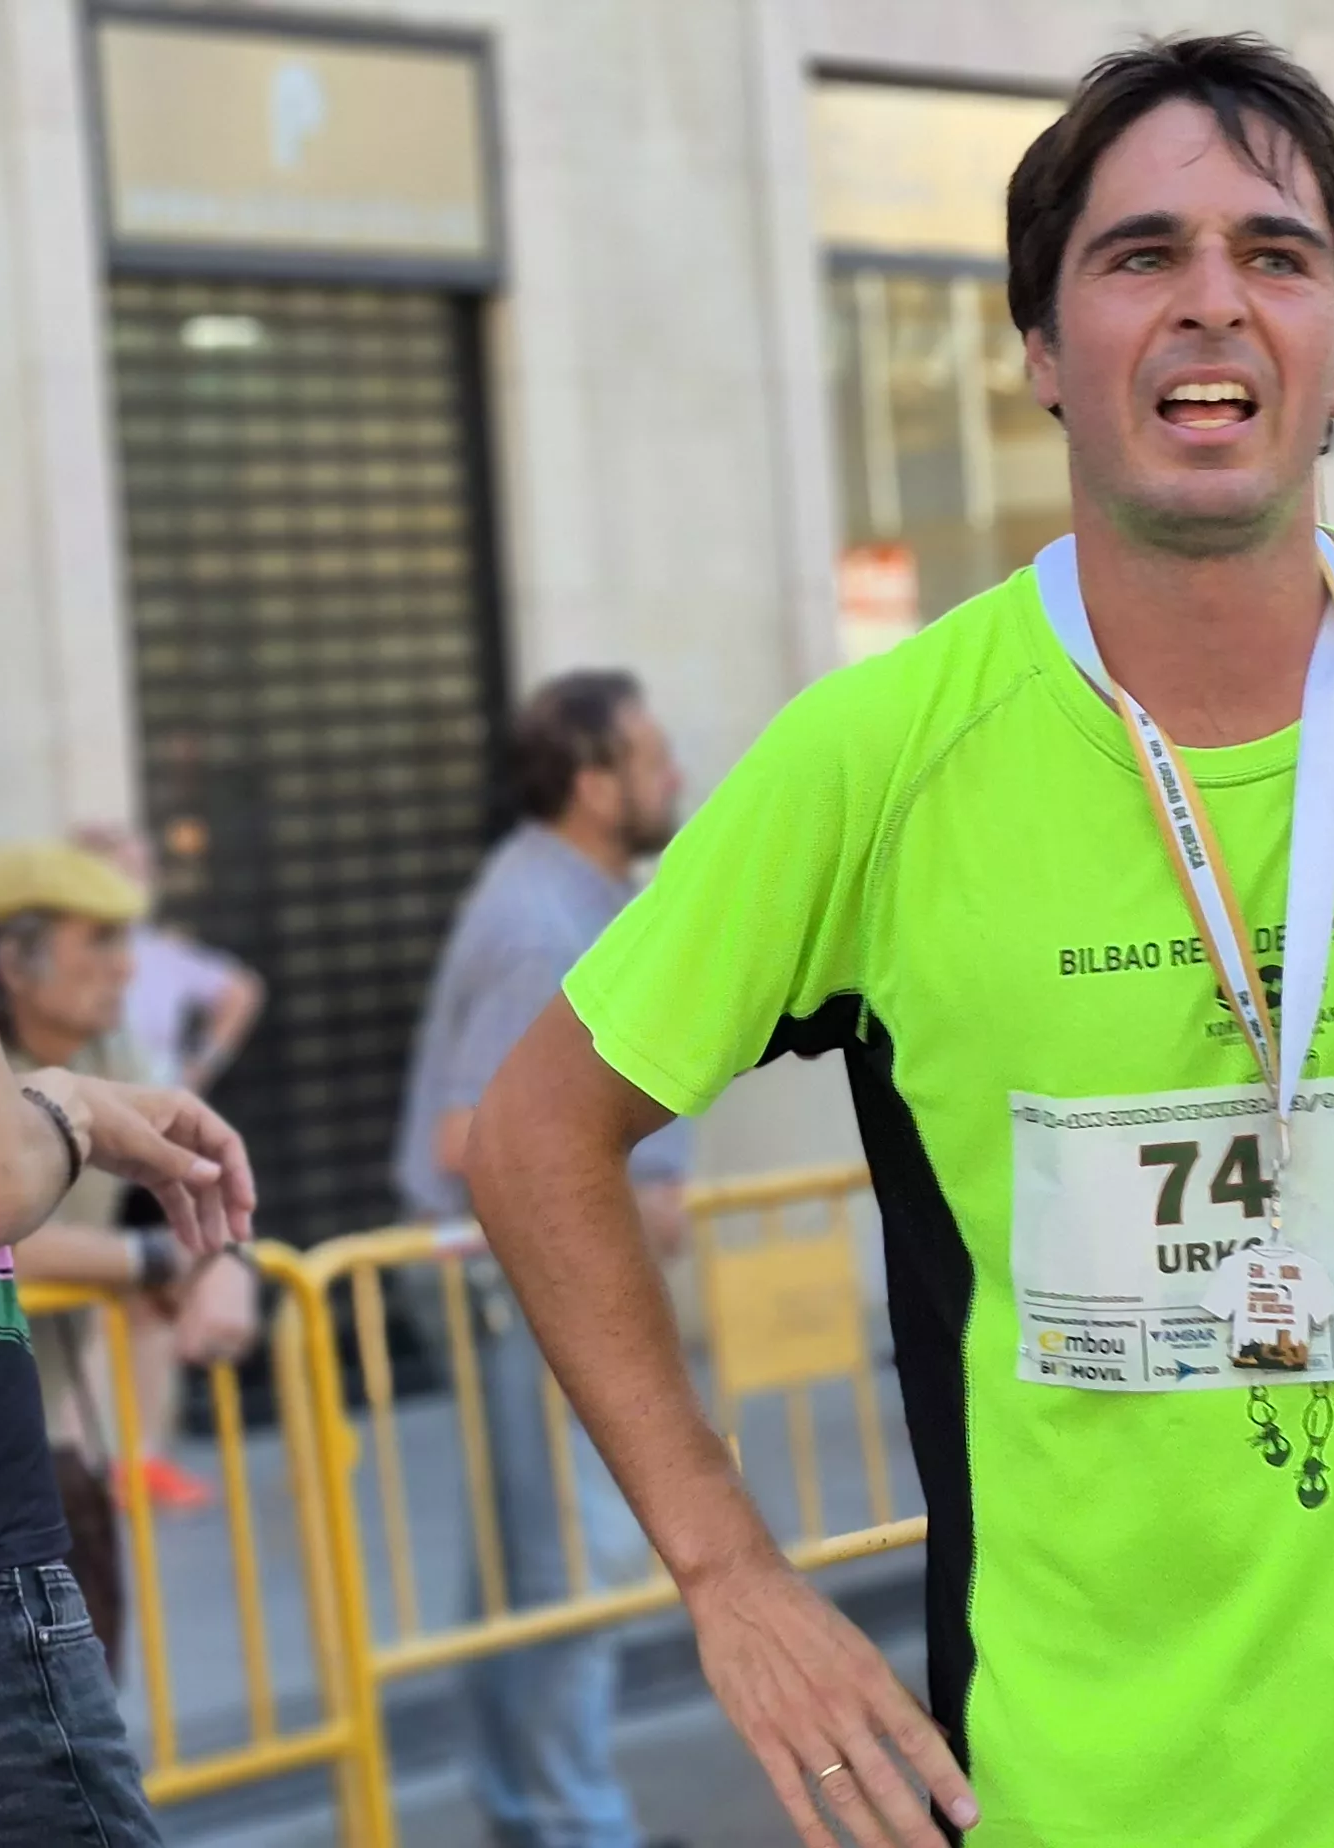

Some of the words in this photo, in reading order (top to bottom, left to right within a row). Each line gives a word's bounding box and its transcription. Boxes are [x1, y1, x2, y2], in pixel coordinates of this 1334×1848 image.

[1059, 942, 1162, 976] BILBAO
[1139, 1134, 1274, 1226] 74
[1038, 1329, 1127, 1356] embou
